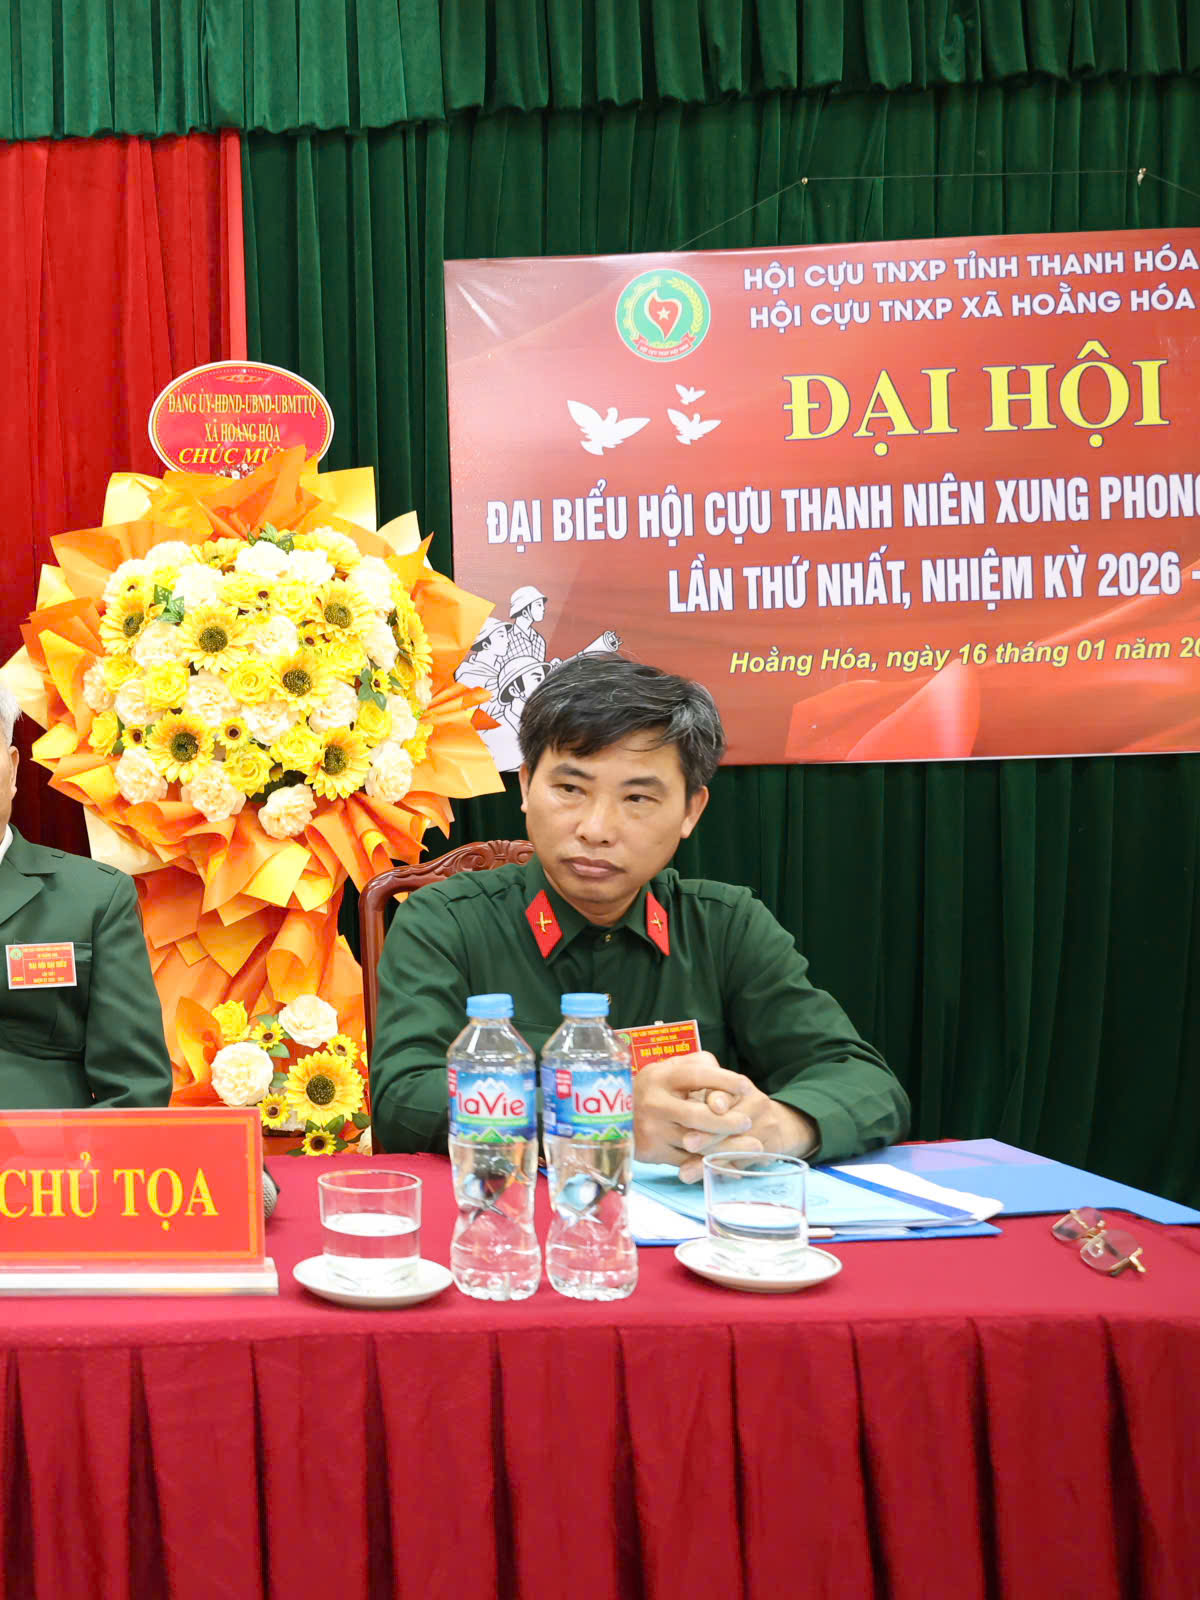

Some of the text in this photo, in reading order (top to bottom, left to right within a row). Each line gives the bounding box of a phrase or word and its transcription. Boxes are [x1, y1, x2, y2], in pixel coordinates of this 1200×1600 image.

[744, 243, 1199, 295] HỘI CỰU TNXP TỈNH THANH HÓA
[750, 282, 1195, 334] HỘI CỰU TNXP XÃ HOẰNG HÓA
[168, 388, 196, 413] ĐẢNG
[782, 340, 1170, 457] ĐẠI HỘI
[179, 443, 238, 464] CHÚC
[486, 472, 1200, 553] ĐẠI BIỂU HỘI CỰU THANH NIÊN XUNG PHON
[668, 553, 733, 613] LẦN
[742, 555, 810, 609] THỨ
[816, 544, 912, 611] NHẤT,
[921, 547, 1033, 611] NHIỆM
[1044, 544, 1087, 599] KỲ
[1097, 551, 1181, 597] 2026
[729, 646, 814, 677] Hoằng
[820, 645, 878, 672] Hóa,
[886, 646, 950, 673] ngày
[958, 643, 988, 665] 16
[995, 641, 1070, 668] tháng
[1077, 639, 1105, 661] 01
[1114, 637, 1171, 661] năm
[113, 1167, 219, 1231] TỌA
